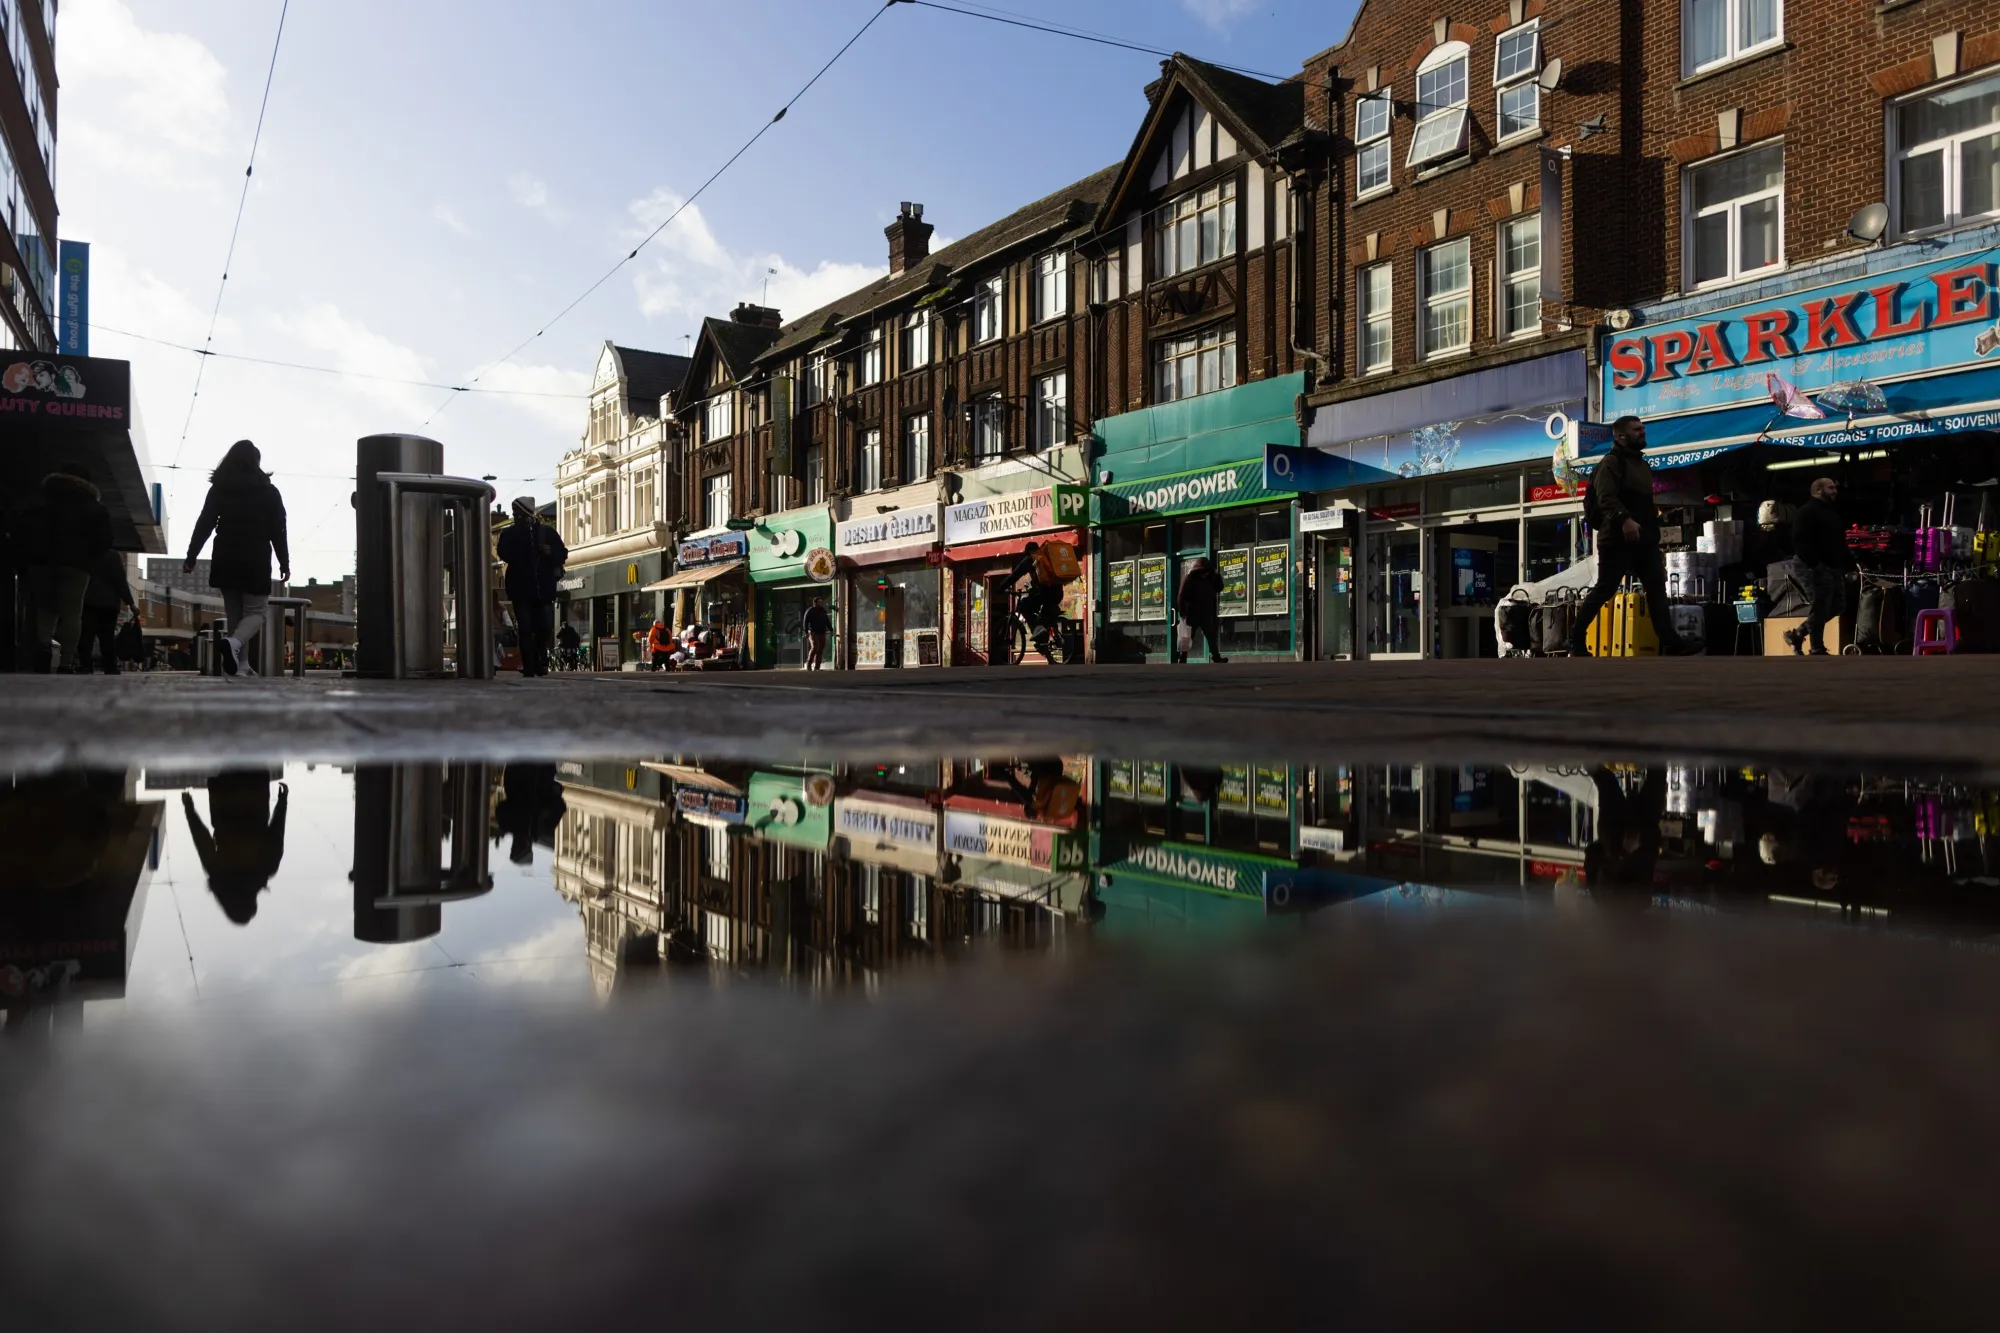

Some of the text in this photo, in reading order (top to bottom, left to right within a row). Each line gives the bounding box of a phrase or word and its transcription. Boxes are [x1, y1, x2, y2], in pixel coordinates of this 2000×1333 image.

[67, 294, 78, 317] gym
[1609, 262, 1991, 390] SPARKLE
[1817, 342, 1926, 372] Accessories
[0, 397, 123, 419] UTY QUEENS
[1545, 412, 1569, 440] O
[1667, 452, 1701, 466] SPORTS
[1814, 430, 1867, 447] LUGGAGE
[1876, 421, 1935, 439] FOOTBALL
[1272, 453, 1295, 482] O2
[953, 493, 1053, 523] MAGAZIN TRADITION
[1060, 493, 1085, 517] PP
[844, 522, 887, 546] DESHY
[889, 514, 935, 539] GRILL
[979, 512, 1038, 534] ROMANESC
